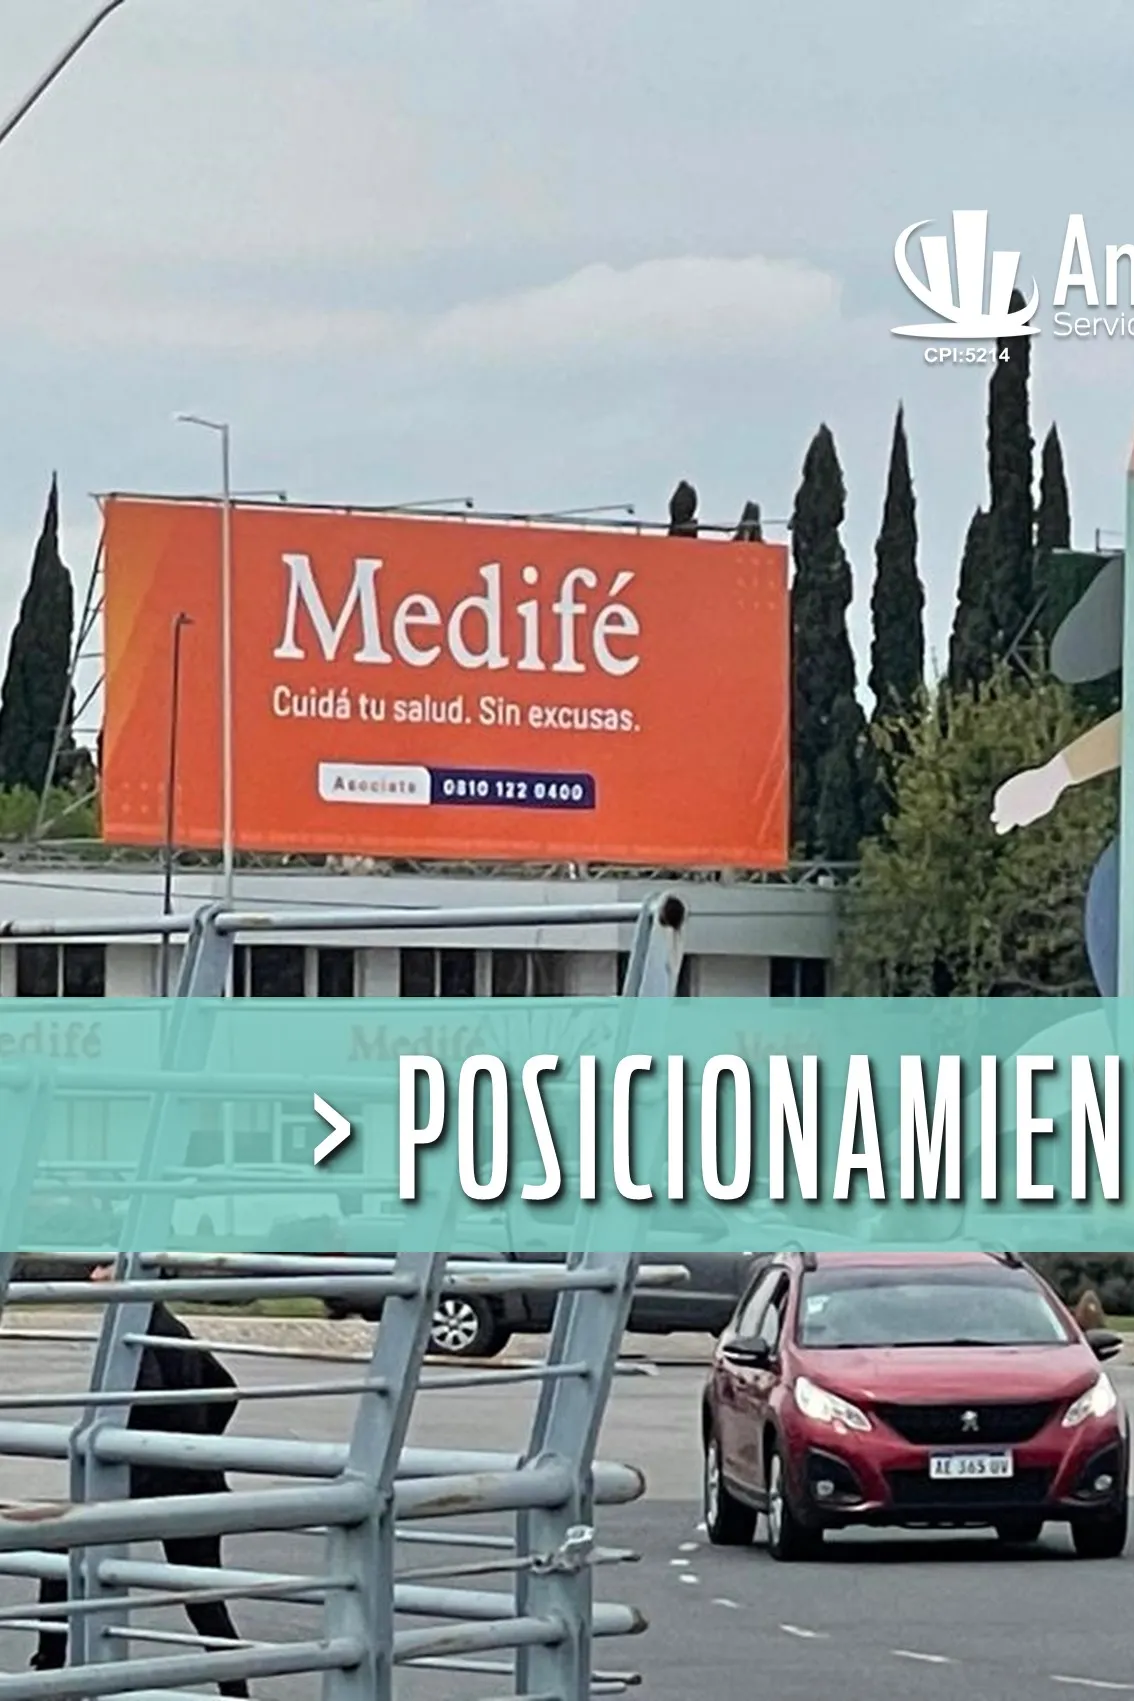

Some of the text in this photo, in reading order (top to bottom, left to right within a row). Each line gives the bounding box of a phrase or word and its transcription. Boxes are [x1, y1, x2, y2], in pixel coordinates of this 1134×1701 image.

[273, 553, 642, 676] Medifé
[272, 685, 641, 733] Cuidá tu salud. Sin excusas.
[0, 1021, 103, 1059] edifé
